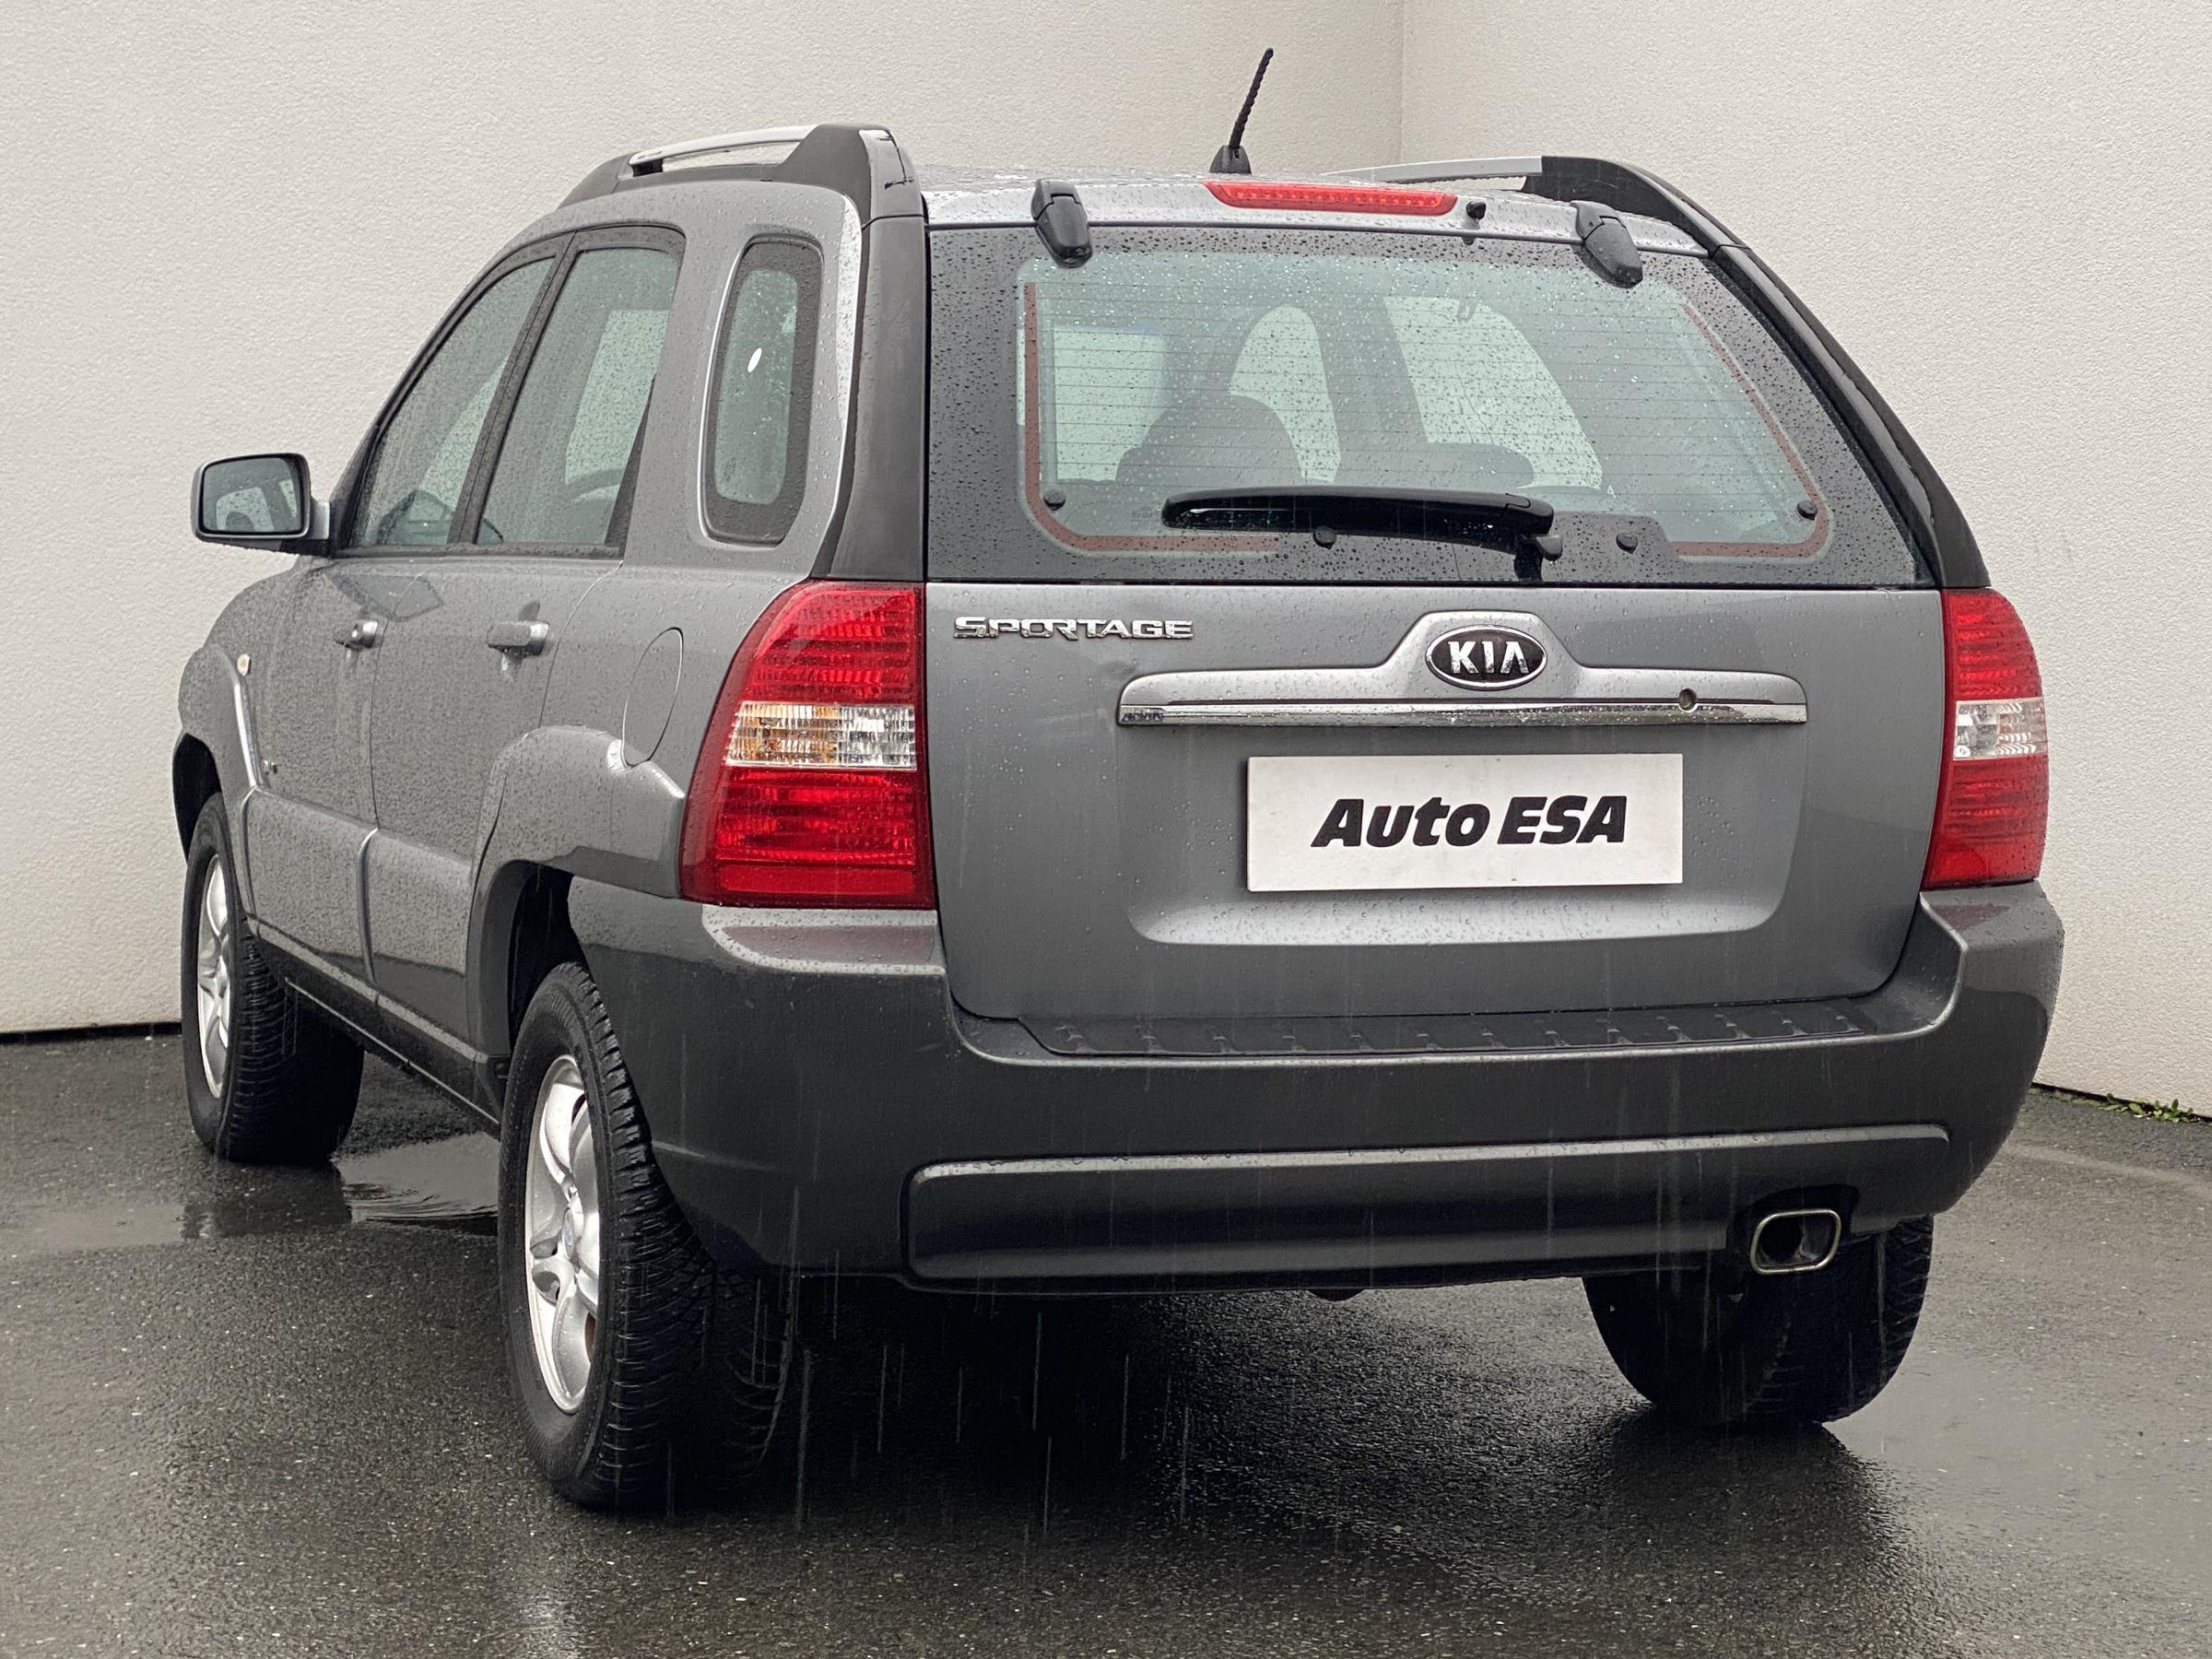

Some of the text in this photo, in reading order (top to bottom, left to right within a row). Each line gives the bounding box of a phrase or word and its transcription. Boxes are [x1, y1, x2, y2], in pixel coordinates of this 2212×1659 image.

[953, 616, 1194, 641] SPORTAGE
[1447, 641, 1530, 674] KIA
[1310, 794, 1628, 848] Auto ESA
